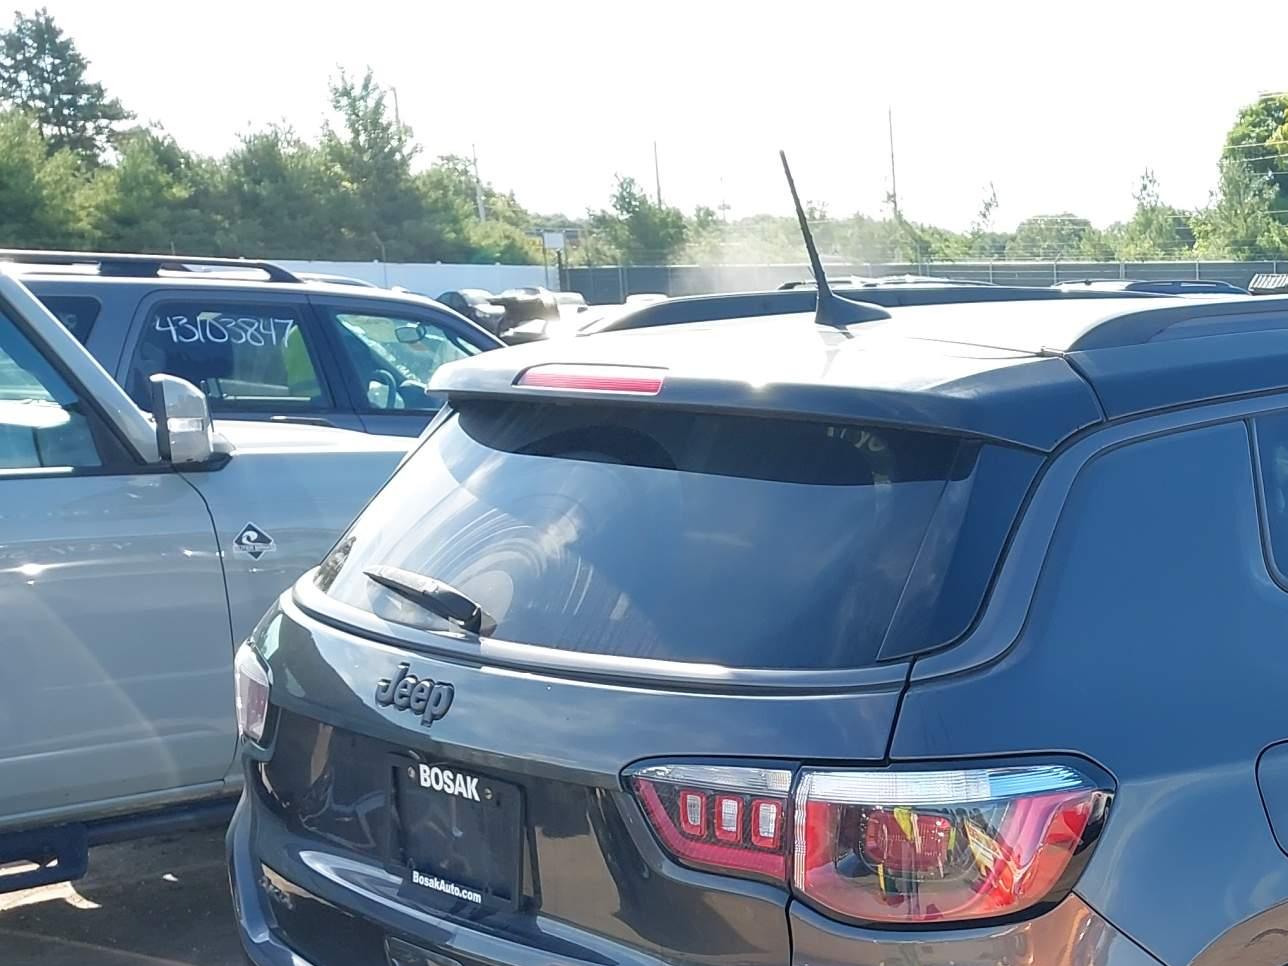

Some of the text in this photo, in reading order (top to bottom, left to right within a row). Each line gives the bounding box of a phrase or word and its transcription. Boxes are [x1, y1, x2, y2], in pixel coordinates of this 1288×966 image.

[155, 315, 294, 348] 43103847
[375, 662, 455, 727] Jeep
[418, 763, 481, 802] BOSAK
[412, 869, 482, 904] BosakAuto.com
